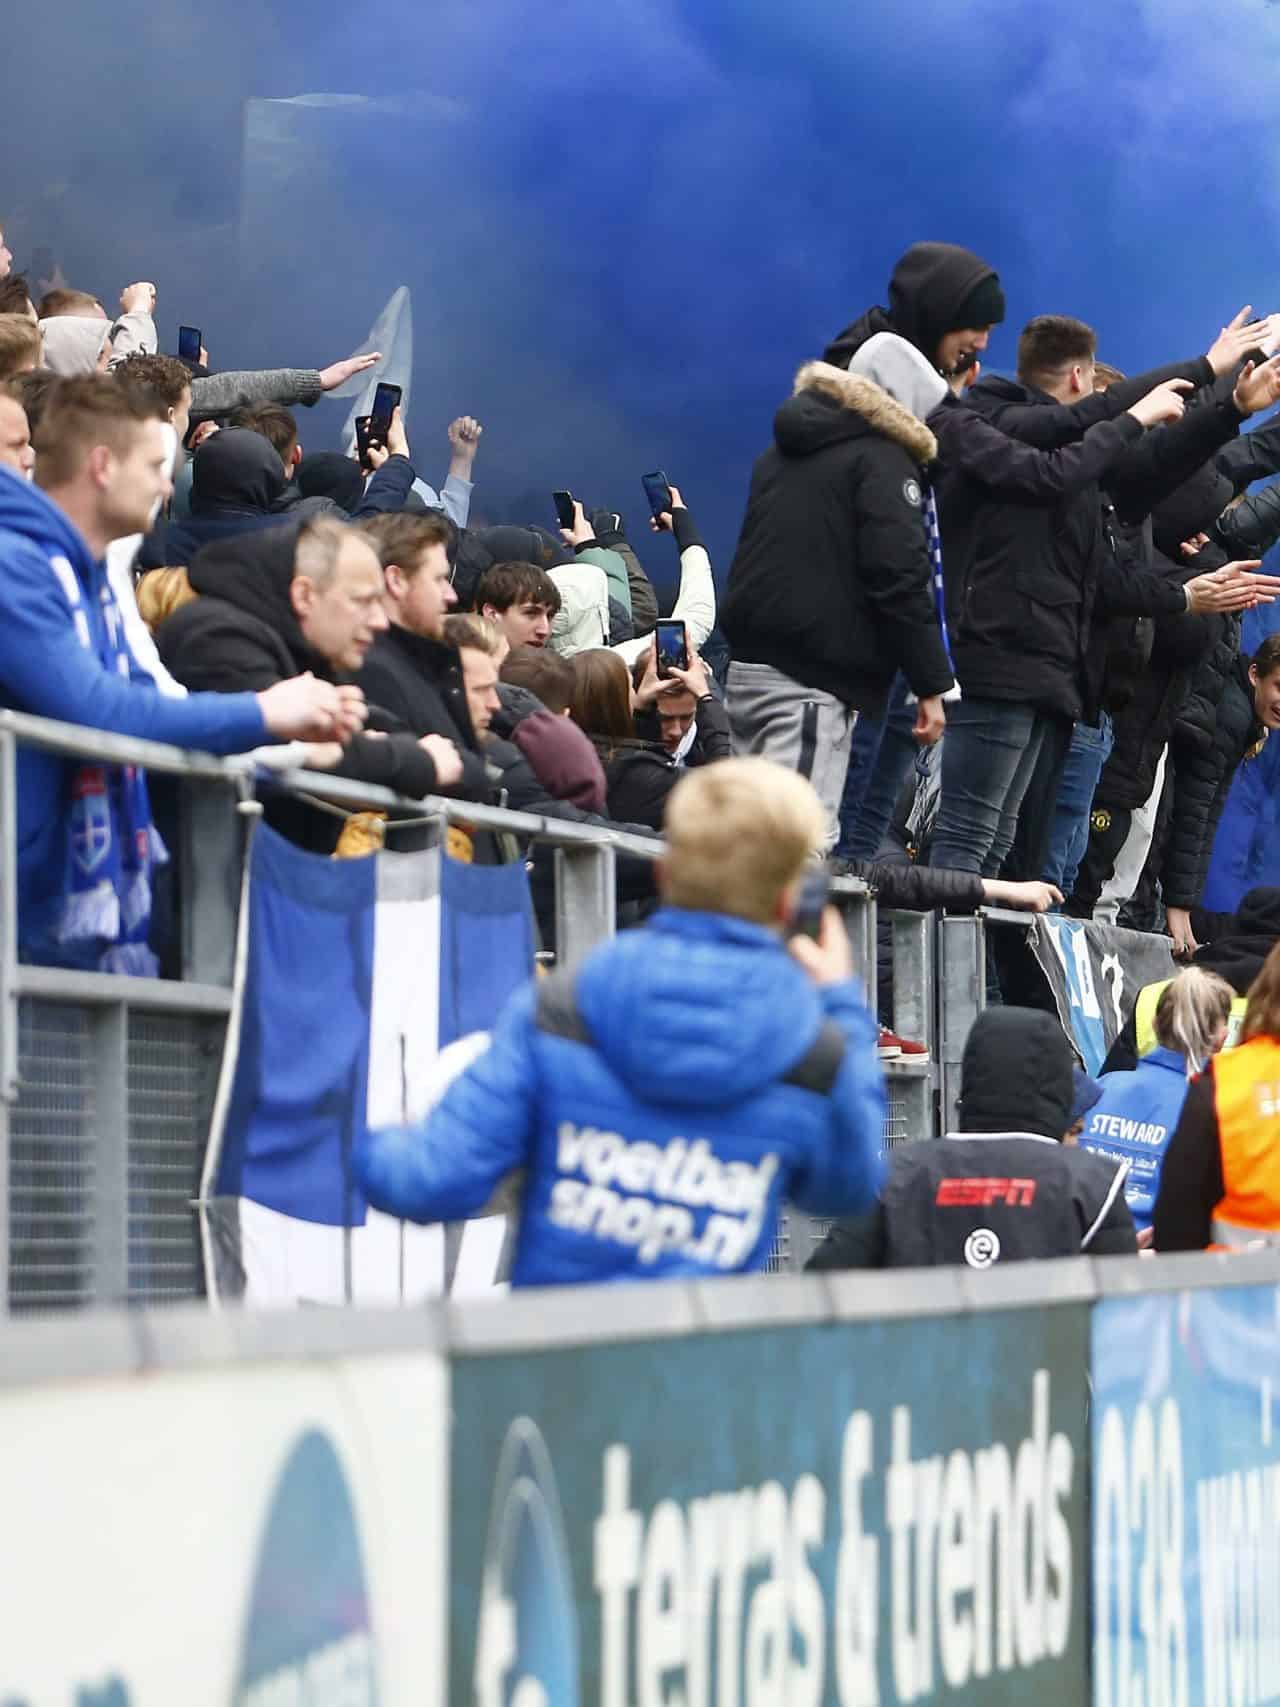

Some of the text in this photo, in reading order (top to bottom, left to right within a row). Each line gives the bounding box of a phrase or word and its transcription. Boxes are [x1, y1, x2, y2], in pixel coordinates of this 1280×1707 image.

[1089, 1113, 1167, 1145] STEWARD
[557, 1121, 780, 1213] voetbal
[935, 1177, 1036, 1206] ESPN
[594, 1368, 1074, 1707] terras & trends
